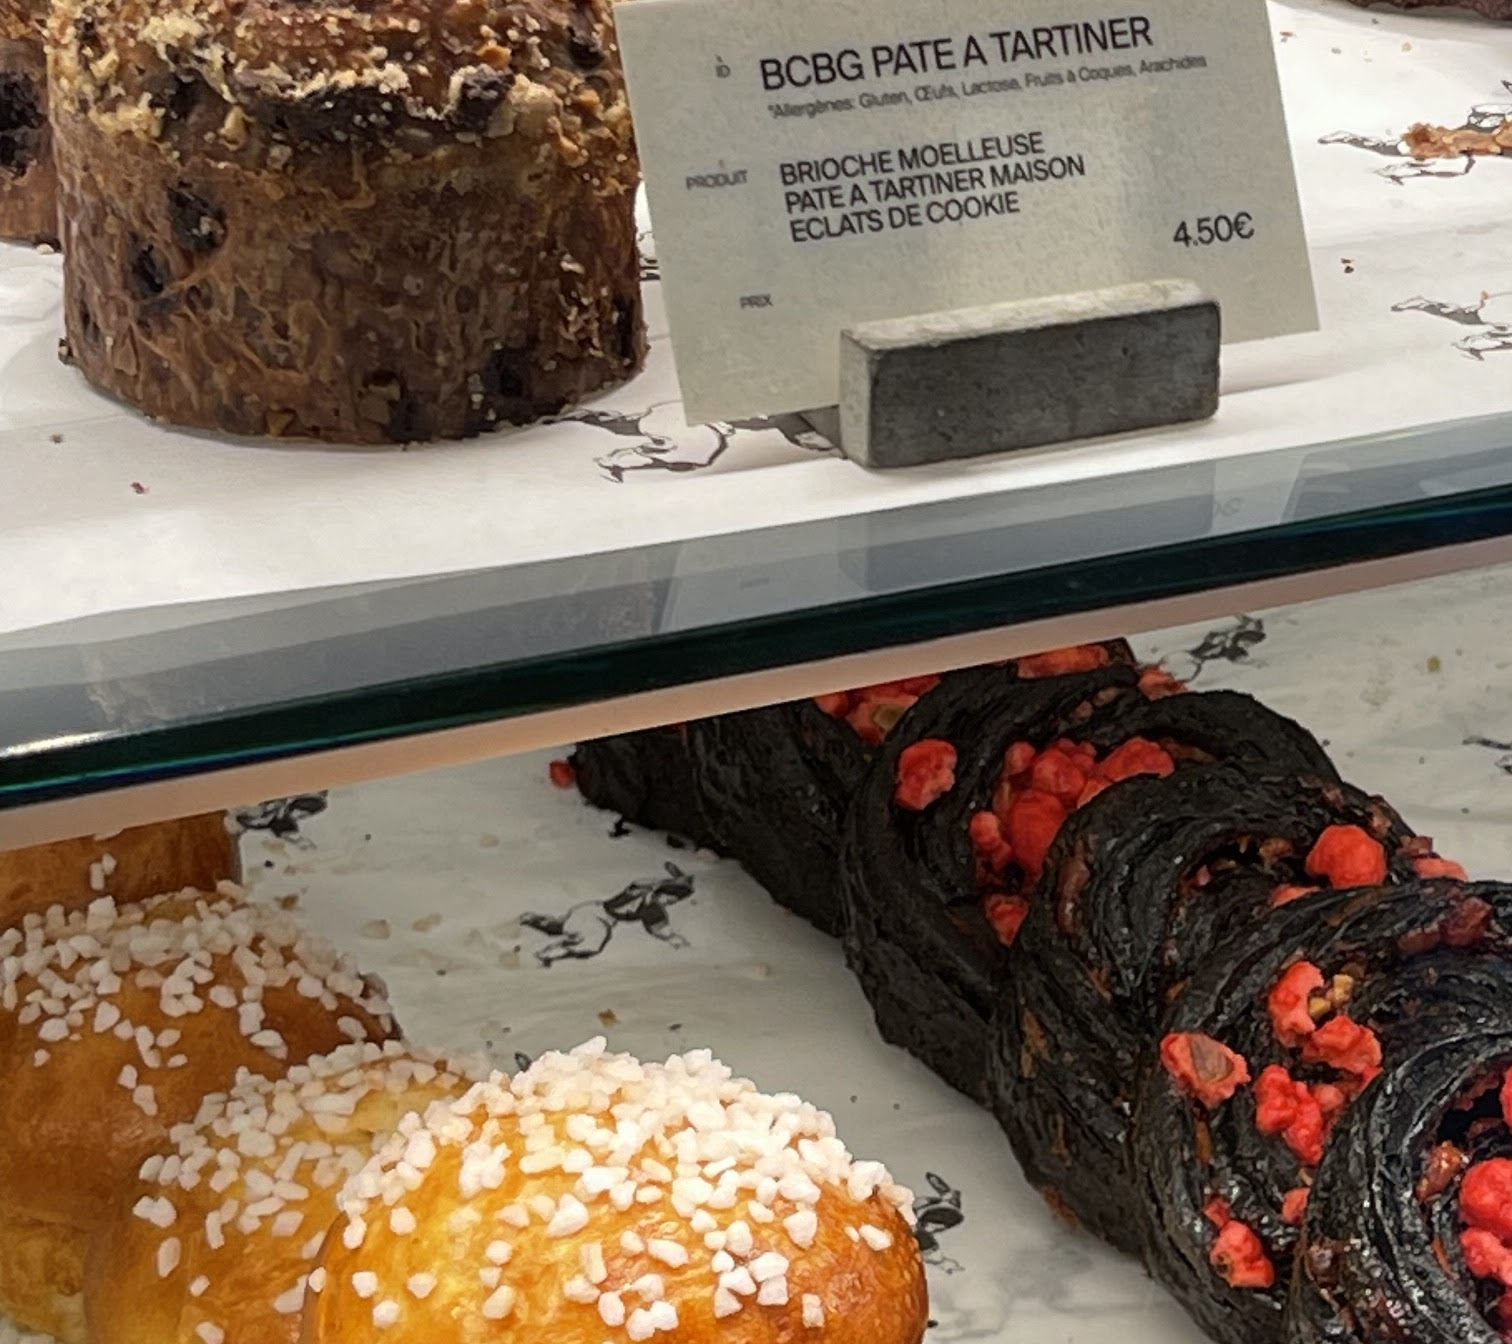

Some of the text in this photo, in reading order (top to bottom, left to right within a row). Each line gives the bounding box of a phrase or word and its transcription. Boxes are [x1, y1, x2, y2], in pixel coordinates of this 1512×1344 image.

[760, 16, 1153, 91] BCBG PATE A TARTINER
[1025, 72, 1063, 88] Fruits
[1139, 55, 1208, 75] Arachides
[686, 169, 748, 190] PRODUIT
[779, 131, 1045, 186] BRIOCHE MOELLEUSE
[784, 154, 1086, 215] PATE A TARTINER MAISON
[789, 191, 1021, 243] ECLATS DE COOKIE
[1172, 211, 1255, 249] 4.50€
